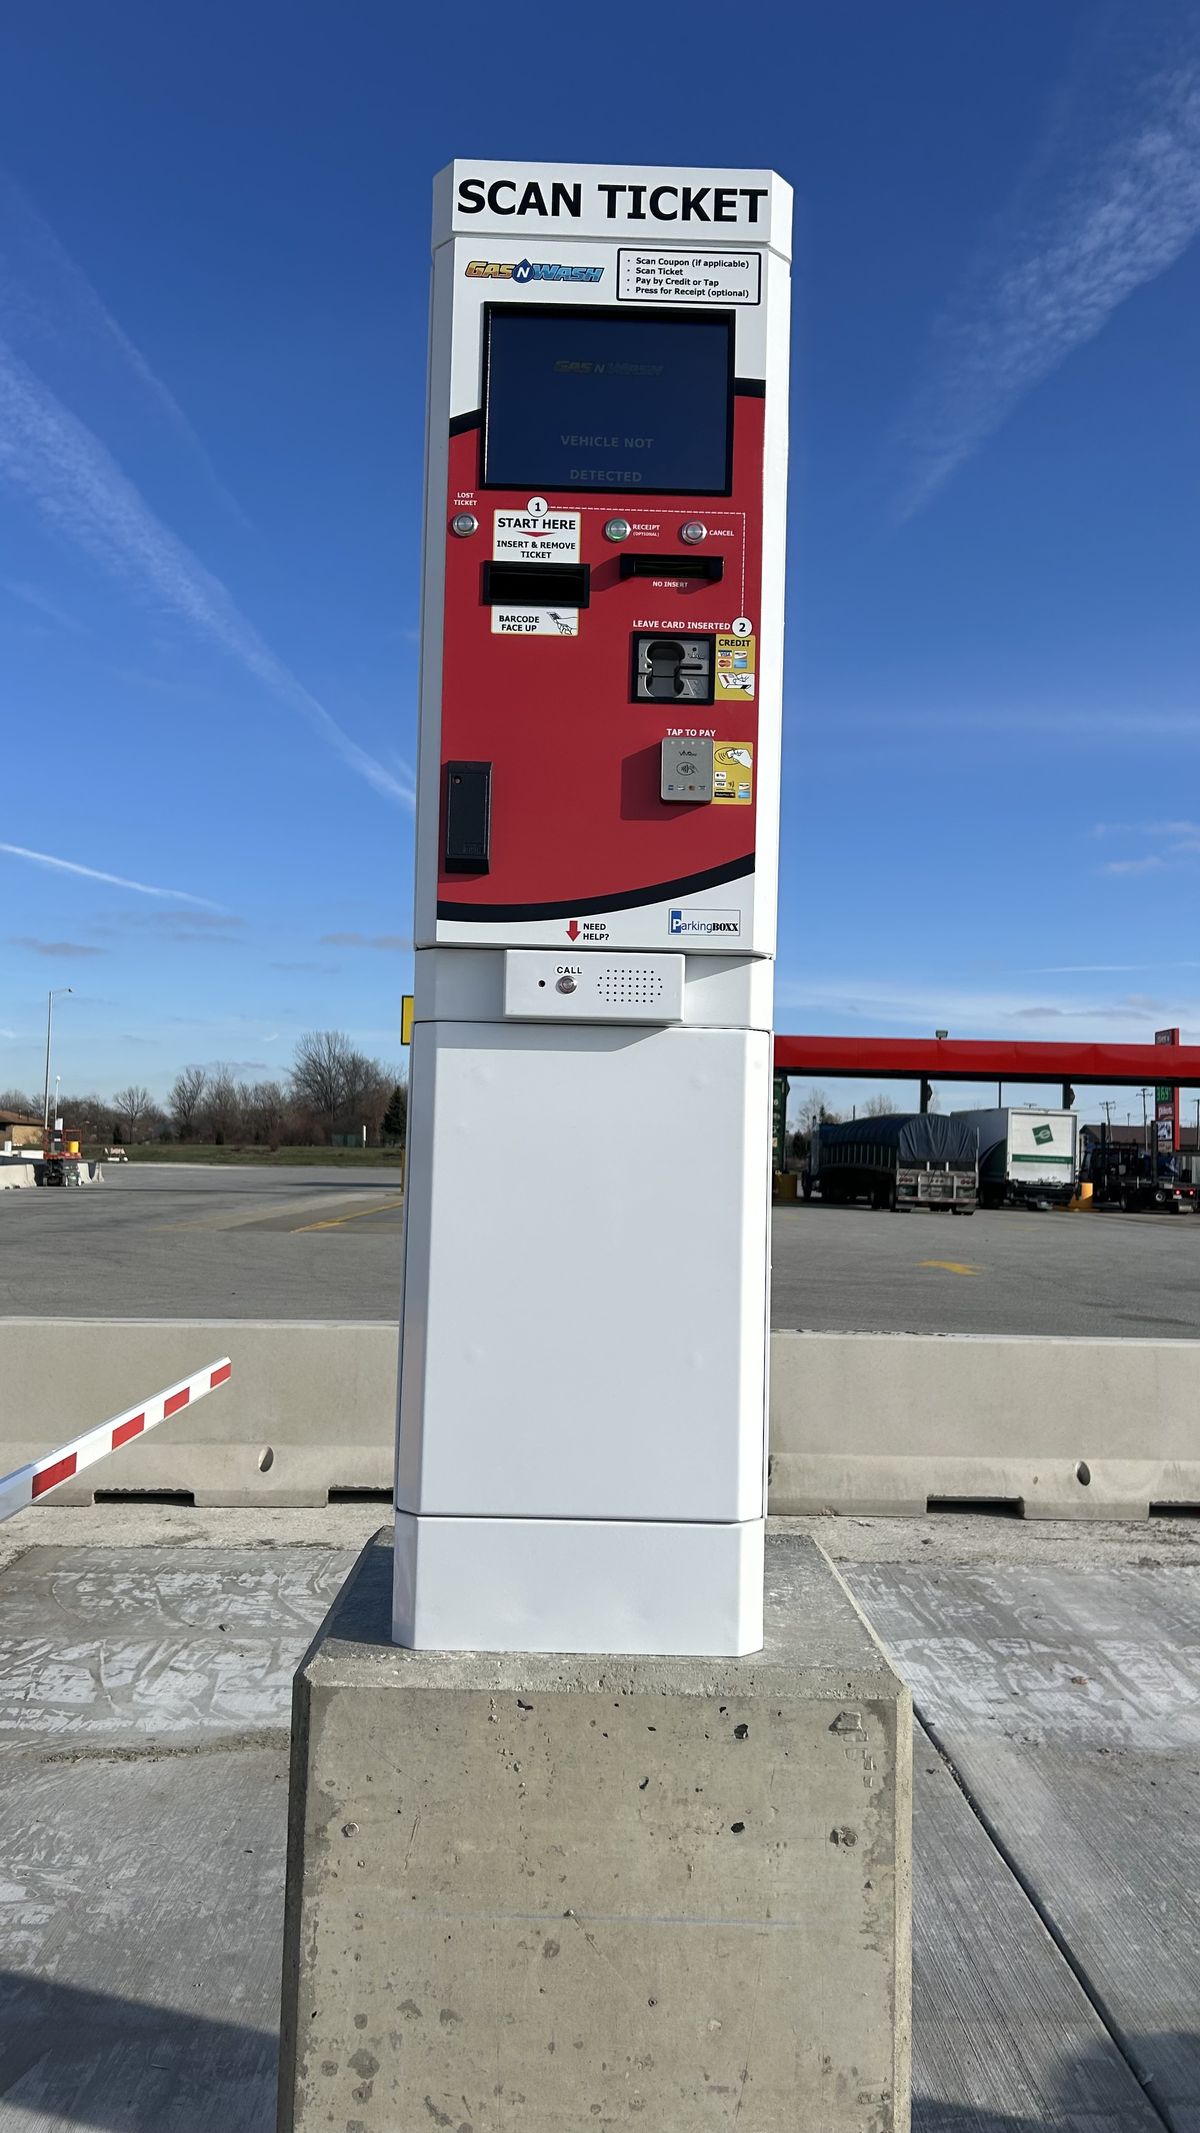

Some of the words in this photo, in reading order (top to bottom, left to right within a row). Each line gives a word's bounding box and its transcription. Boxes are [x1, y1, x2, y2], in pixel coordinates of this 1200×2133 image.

[457, 179, 582, 218] SCAN
[598, 184, 769, 222] TICKET
[658, 258, 690, 268] Coupon
[691, 258, 702, 268] (if
[703, 259, 750, 269] applicable)
[636, 267, 657, 275] Scan
[658, 268, 683, 276] Ticket
[636, 277, 647, 286] Pay
[649, 277, 662, 287] by
[665, 278, 691, 286] Credit
[703, 278, 719, 288] Tap
[636, 288, 658, 296] Press
[660, 288, 672, 296] for
[674, 288, 705, 298] Receipt
[707, 288, 749, 299] (optional)
[561, 435, 619, 448] VEHICLE
[624, 437, 654, 449] NOT
[569, 469, 642, 483] DETECTED
[534, 502, 542, 512] 1
[498, 517, 538, 529] START
[542, 519, 576, 530] HERE
[633, 523, 660, 531] RECEIPT
[497, 540, 529, 548] INSERT
[521, 551, 552, 559] TICKET
[499, 615, 540, 623] BARCODE
[633, 620, 660, 629] LEAVE
[661, 621, 685, 629] CARD
[687, 622, 731, 630] INSERTED
[739, 623, 746, 632] 2
[718, 639, 751, 647] CREDIT
[667, 728, 684, 736] TAP
[686, 729, 697, 737] TO
[699, 729, 716, 737] PAY
